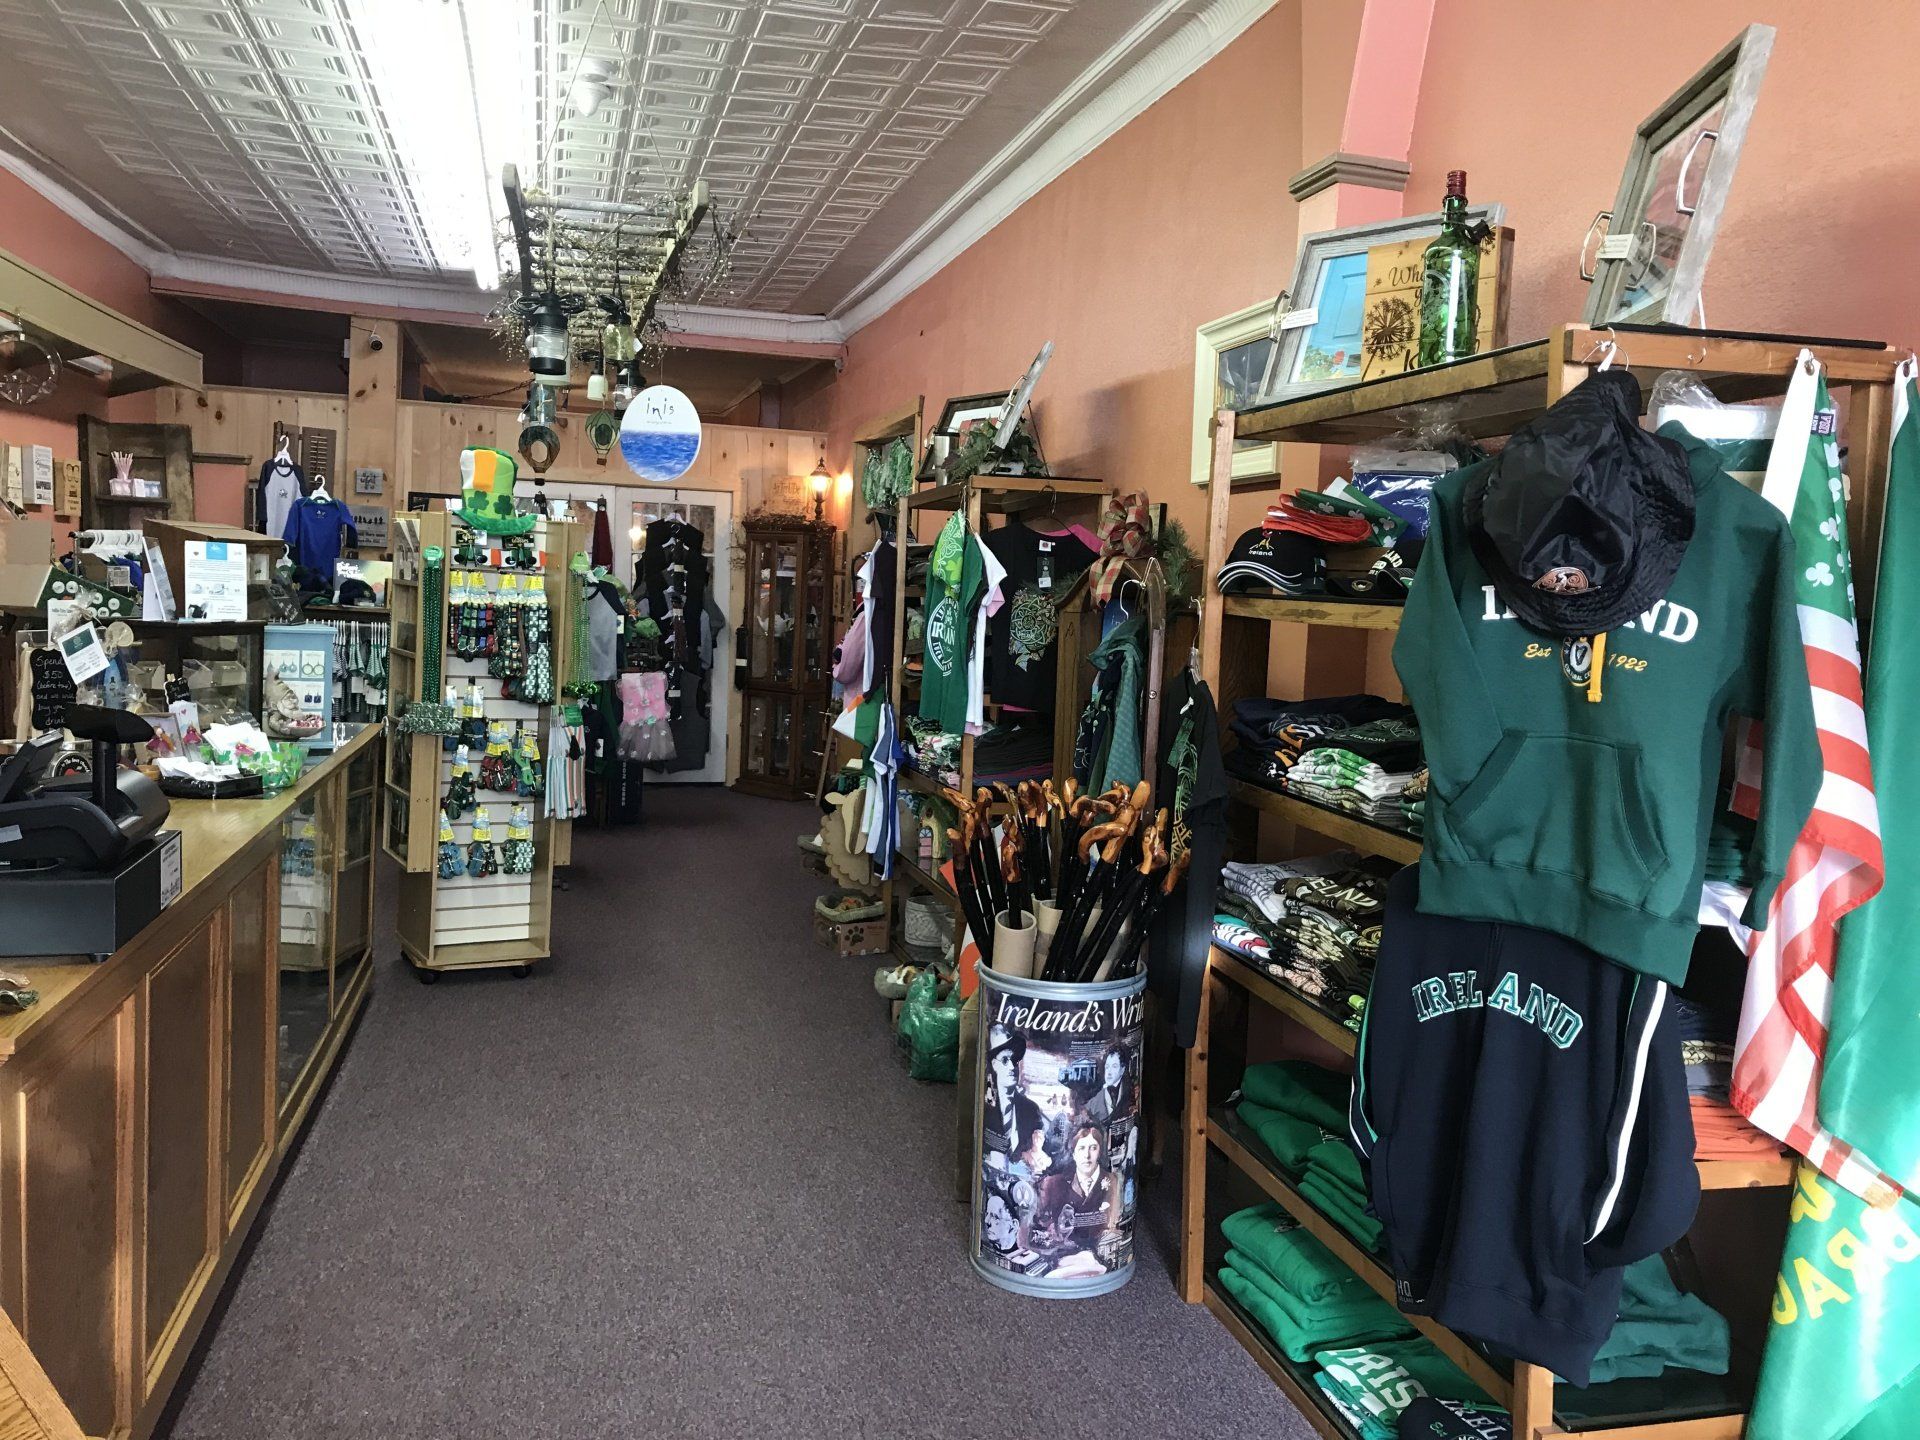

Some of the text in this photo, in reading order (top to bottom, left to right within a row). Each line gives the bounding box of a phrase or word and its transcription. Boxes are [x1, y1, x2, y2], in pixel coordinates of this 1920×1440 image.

[647, 397, 675, 420] inis
[1818, 415, 1832, 435] USA
[35, 655, 65, 670] Spend
[1523, 643, 1648, 672] Est 1922
[995, 993, 1105, 1033] Ireland's
[1412, 970, 1584, 1050] IRELAND
[1325, 1347, 1429, 1414] IRIS
